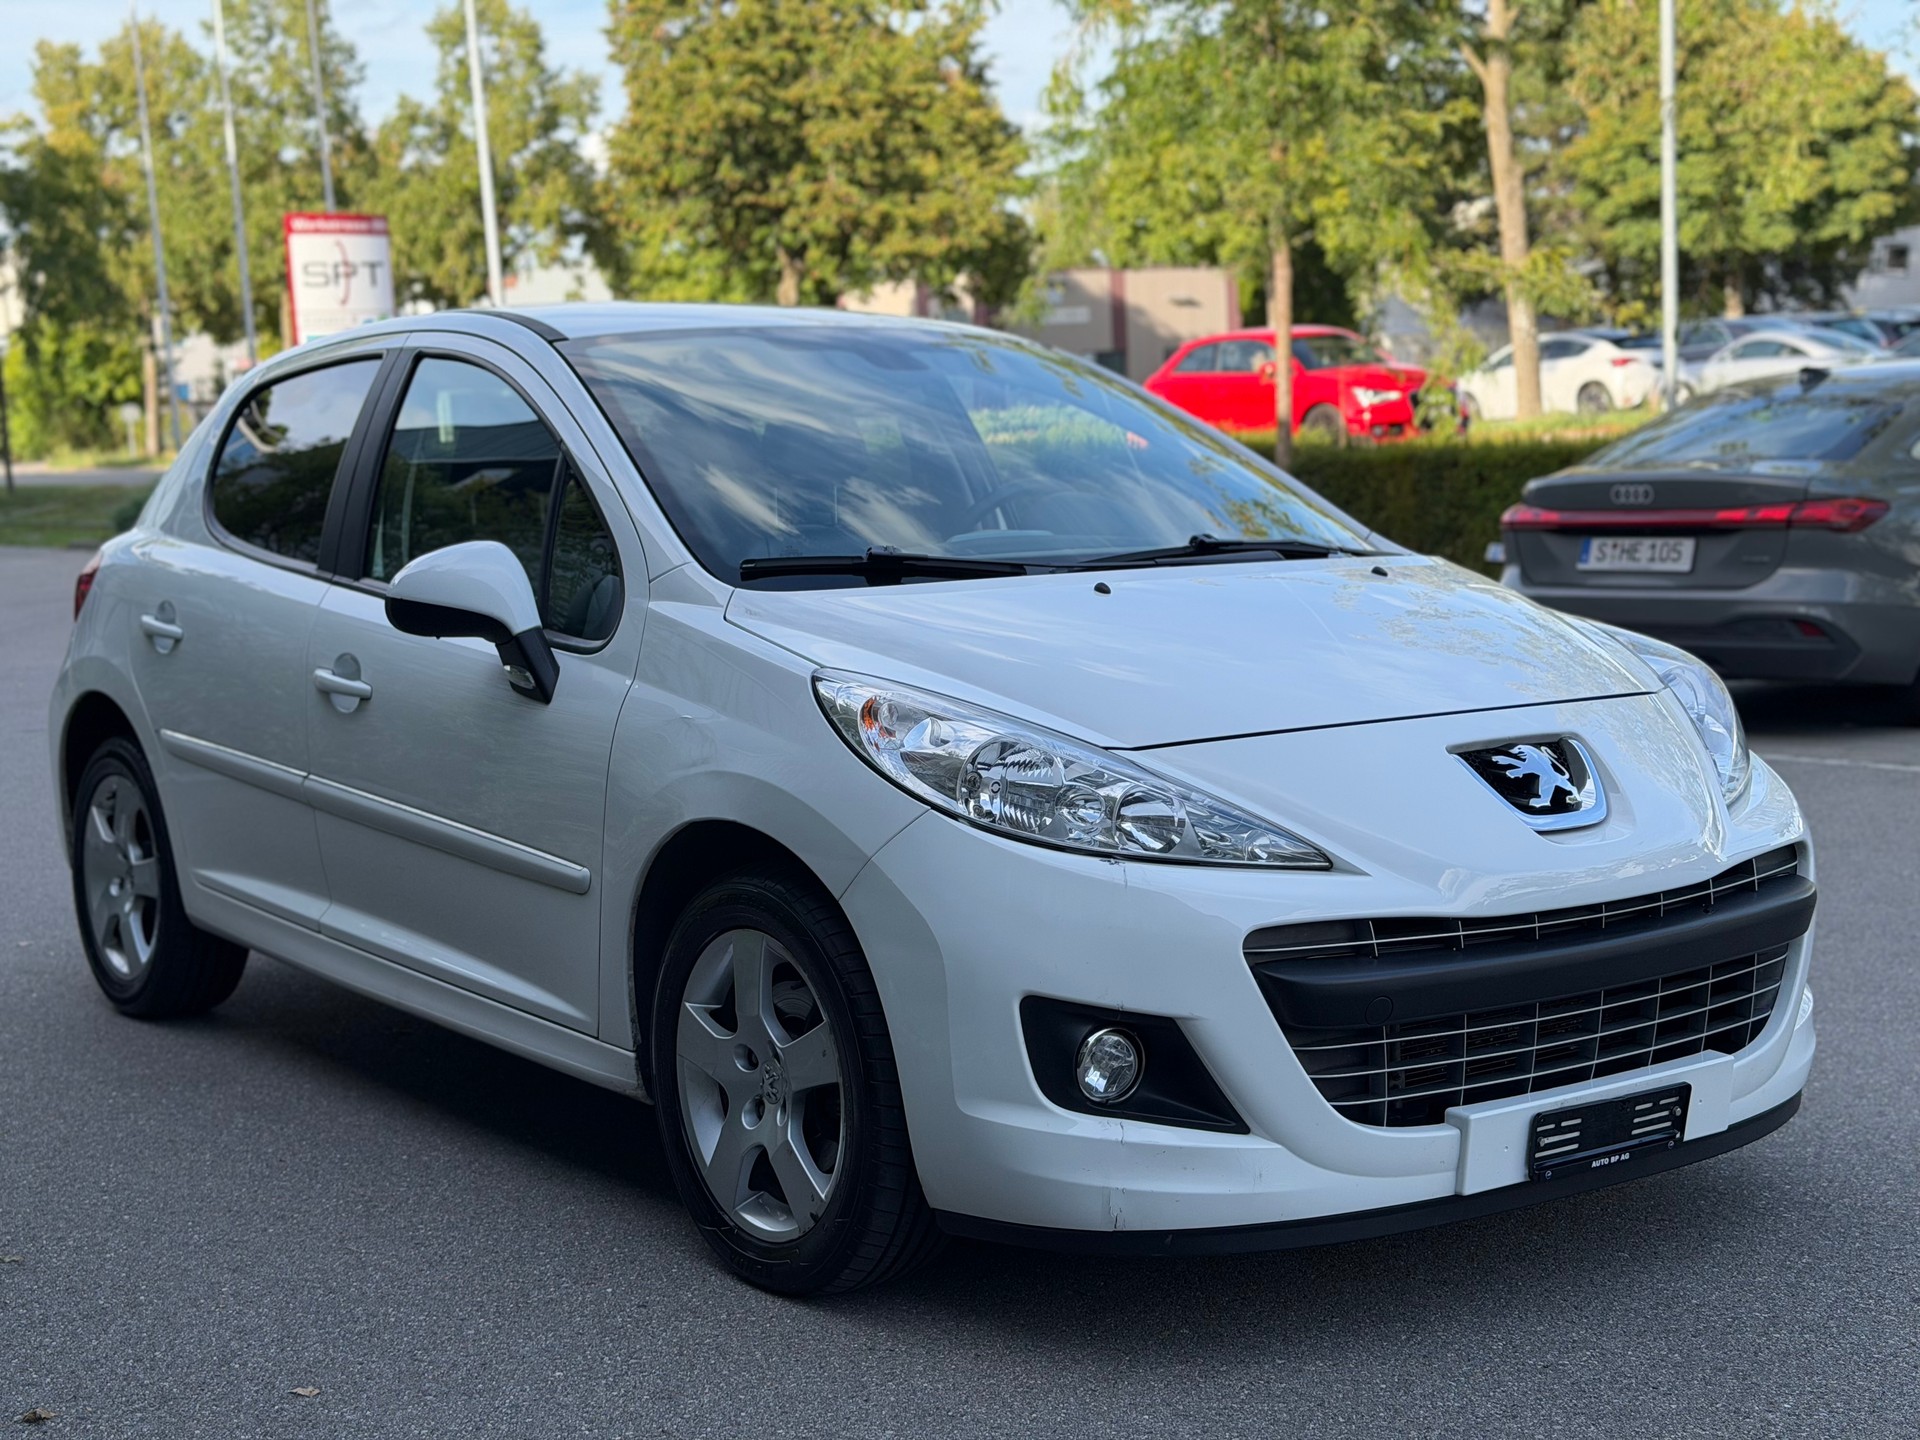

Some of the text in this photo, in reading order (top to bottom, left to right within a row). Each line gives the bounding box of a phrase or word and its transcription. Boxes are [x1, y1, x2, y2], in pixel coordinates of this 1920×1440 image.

[303, 261, 384, 288] SPT
[1595, 541, 1609, 562] S
[1647, 541, 1683, 562] 105
[1591, 1152, 1630, 1168] AUTO BP AG
